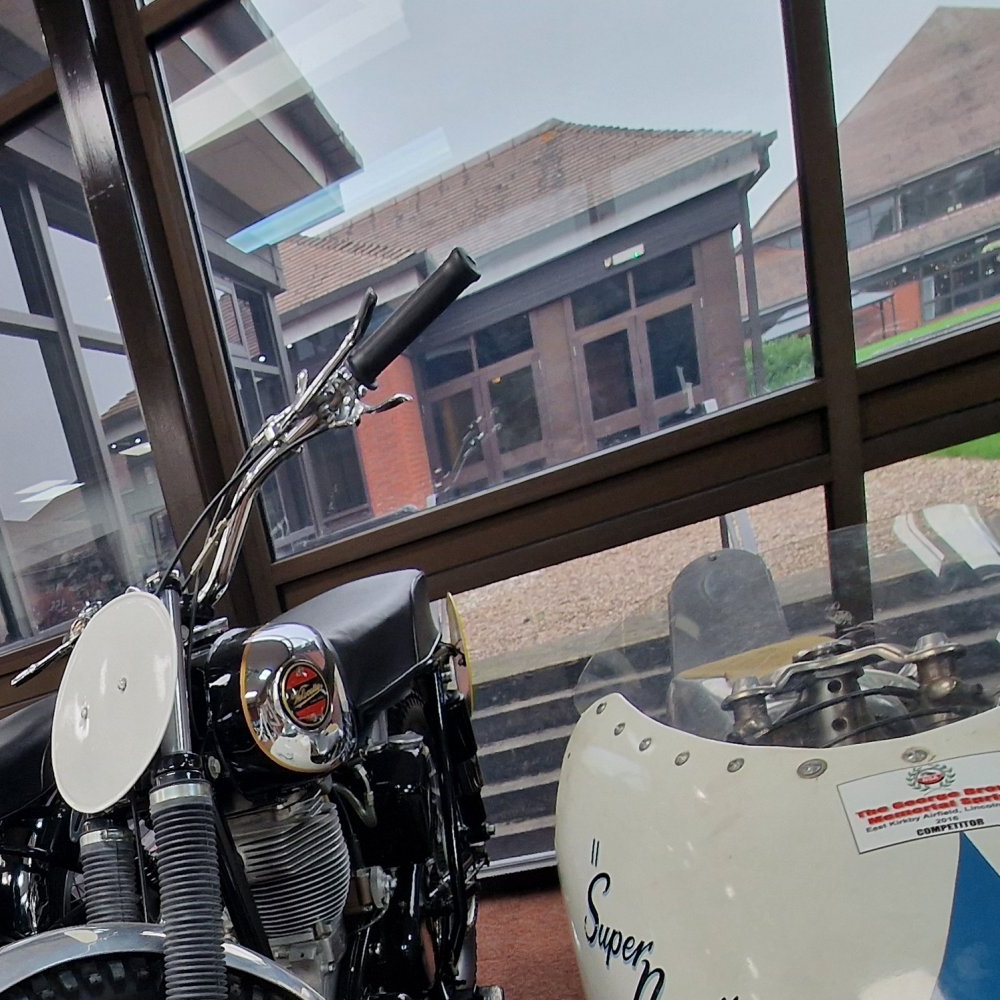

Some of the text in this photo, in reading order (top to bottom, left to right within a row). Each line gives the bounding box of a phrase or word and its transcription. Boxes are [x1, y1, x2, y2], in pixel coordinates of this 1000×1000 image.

[855, 785, 1000, 818] The George Bro
[867, 800, 957, 824] Memorial
[865, 823, 887, 833] East
[889, 816, 920, 827] Kirkby
[917, 818, 985, 836] COMPETITOR
